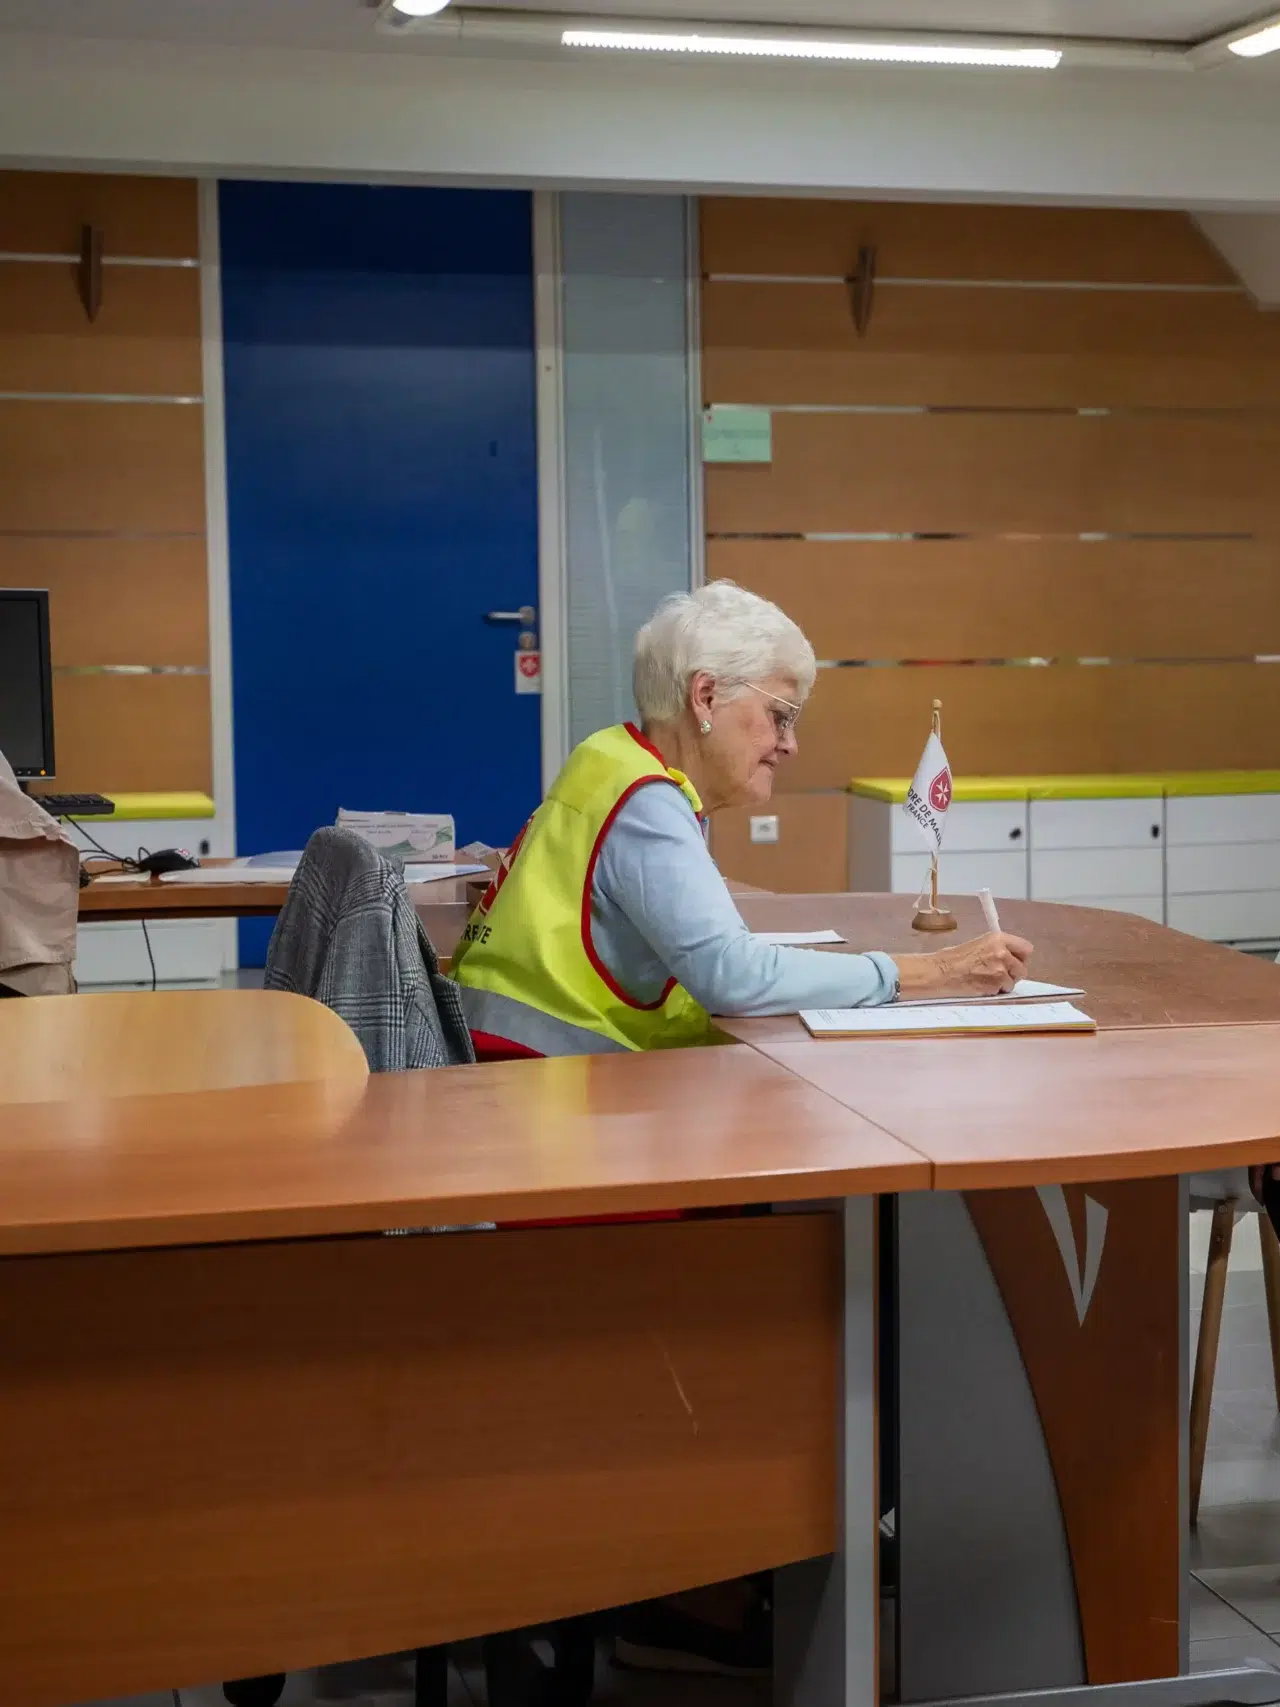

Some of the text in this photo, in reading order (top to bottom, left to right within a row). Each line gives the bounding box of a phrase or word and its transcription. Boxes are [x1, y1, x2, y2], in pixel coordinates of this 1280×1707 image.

[907, 785, 922, 807] DRE
[919, 804, 932, 819] DE
[907, 803, 929, 829] FRANCE
